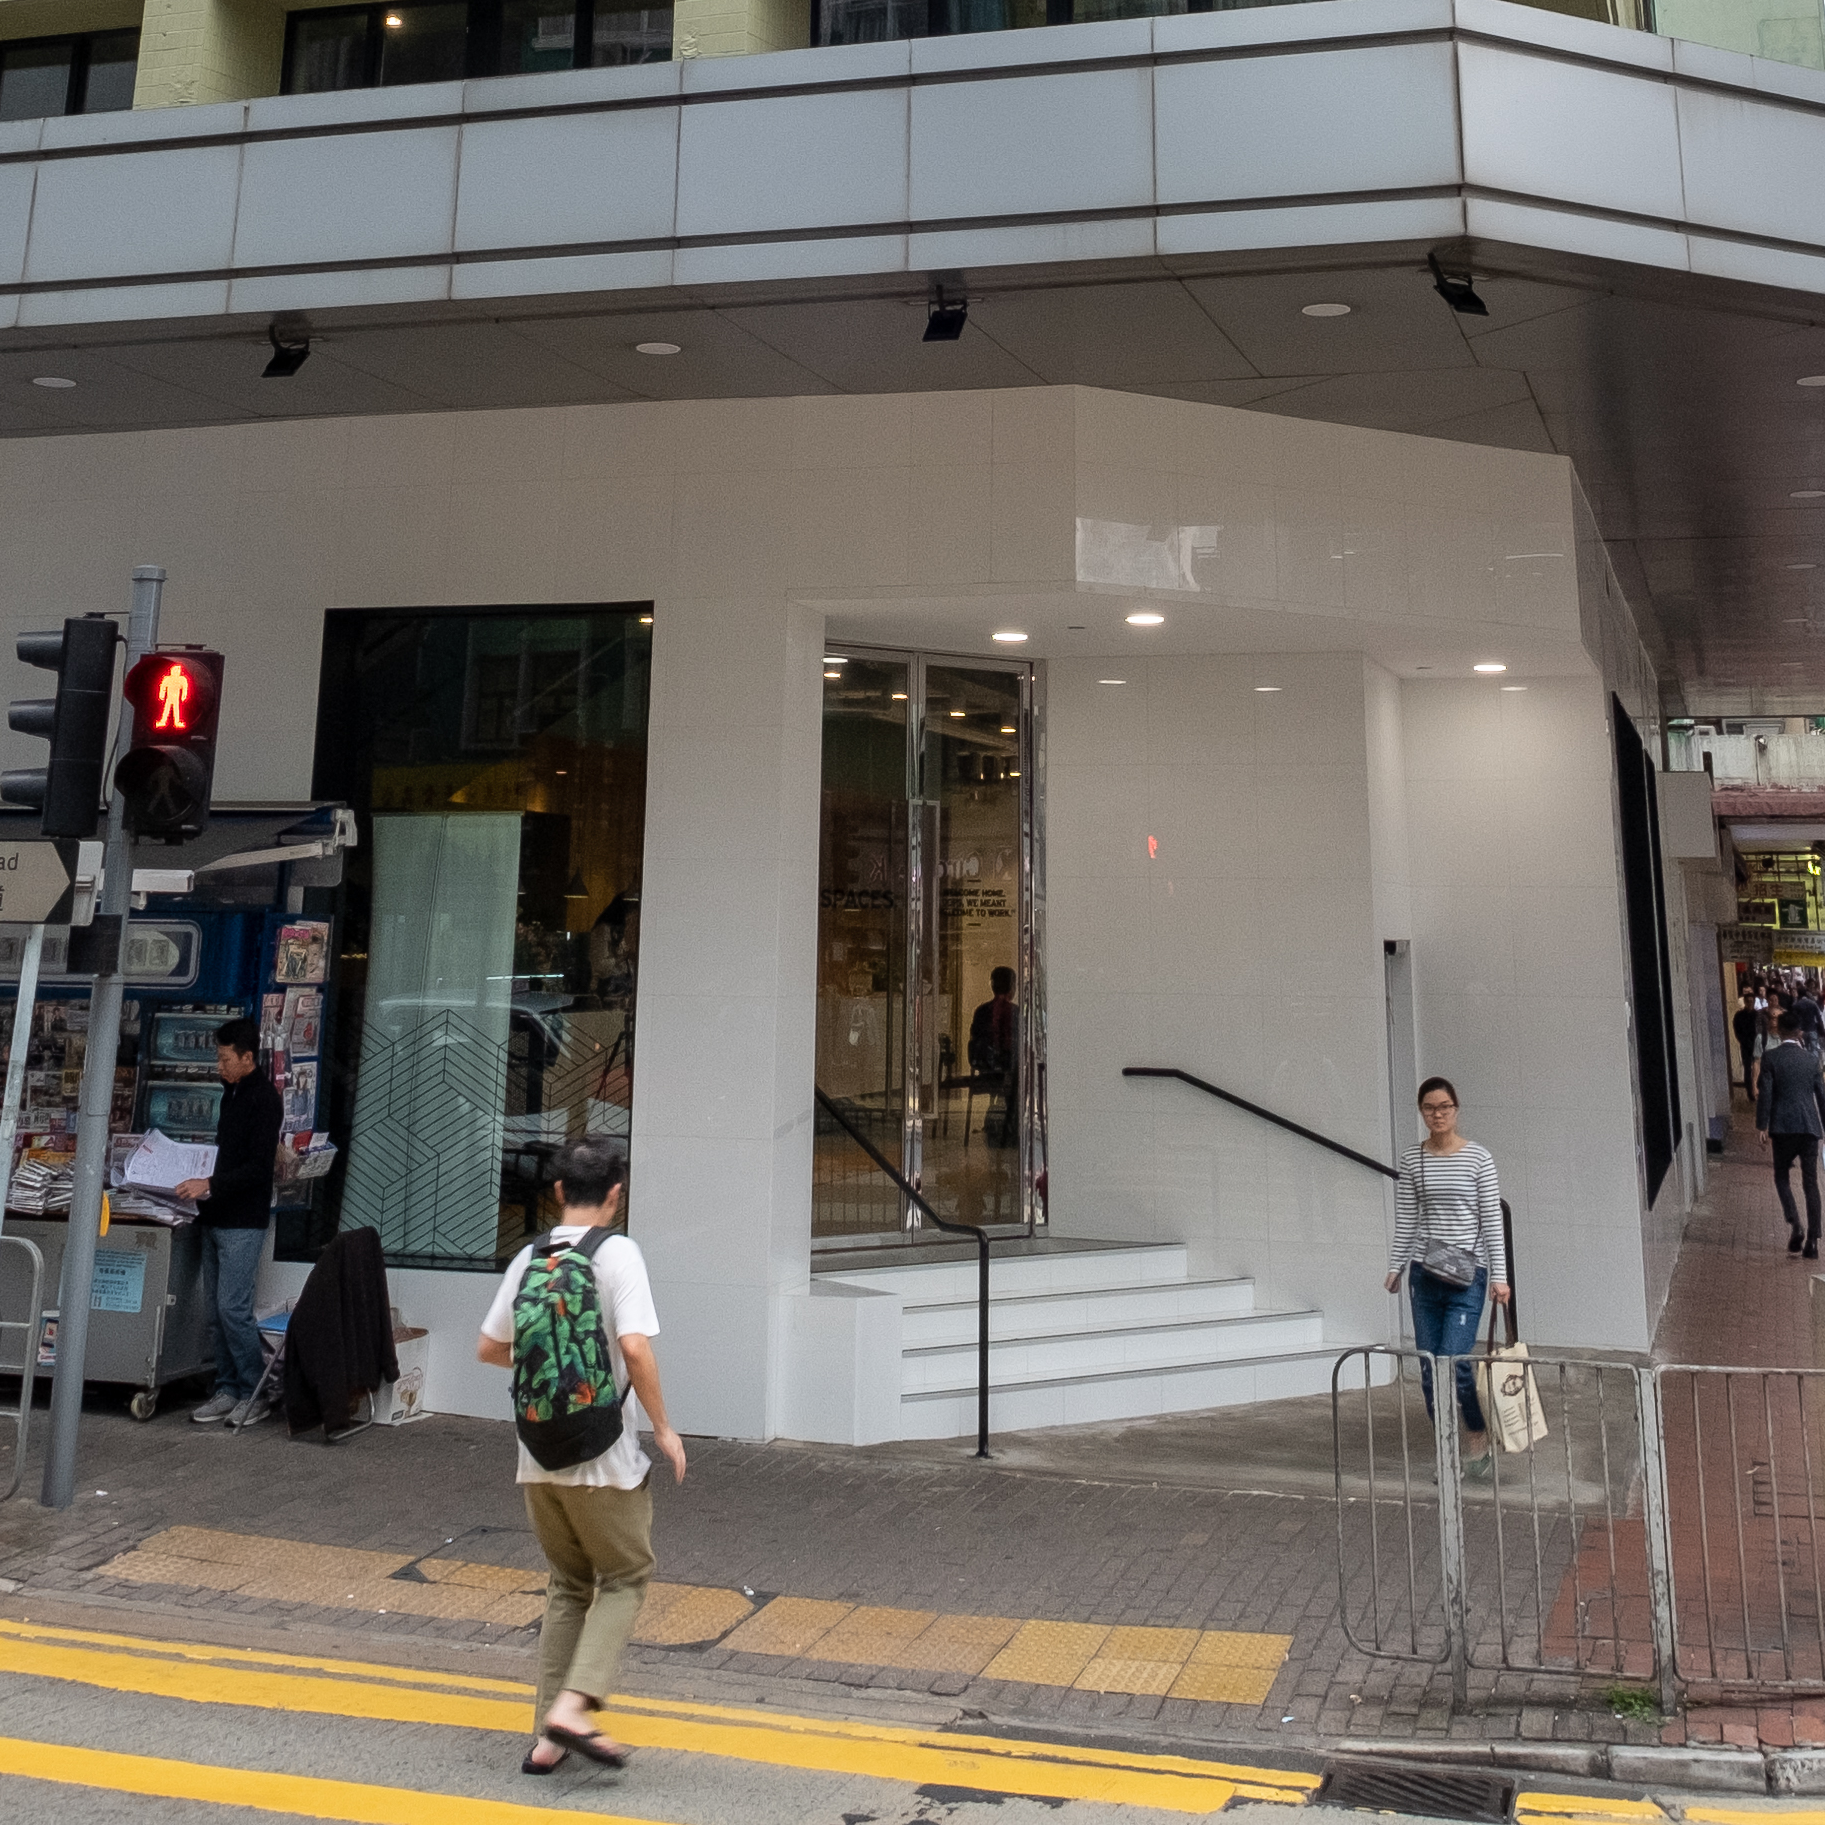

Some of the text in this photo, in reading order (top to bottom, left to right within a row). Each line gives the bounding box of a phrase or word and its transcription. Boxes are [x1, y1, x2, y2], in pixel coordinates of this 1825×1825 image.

[966, 898, 978, 908] WE
[980, 898, 1007, 908] MEANT
[976, 909, 987, 917] TO
